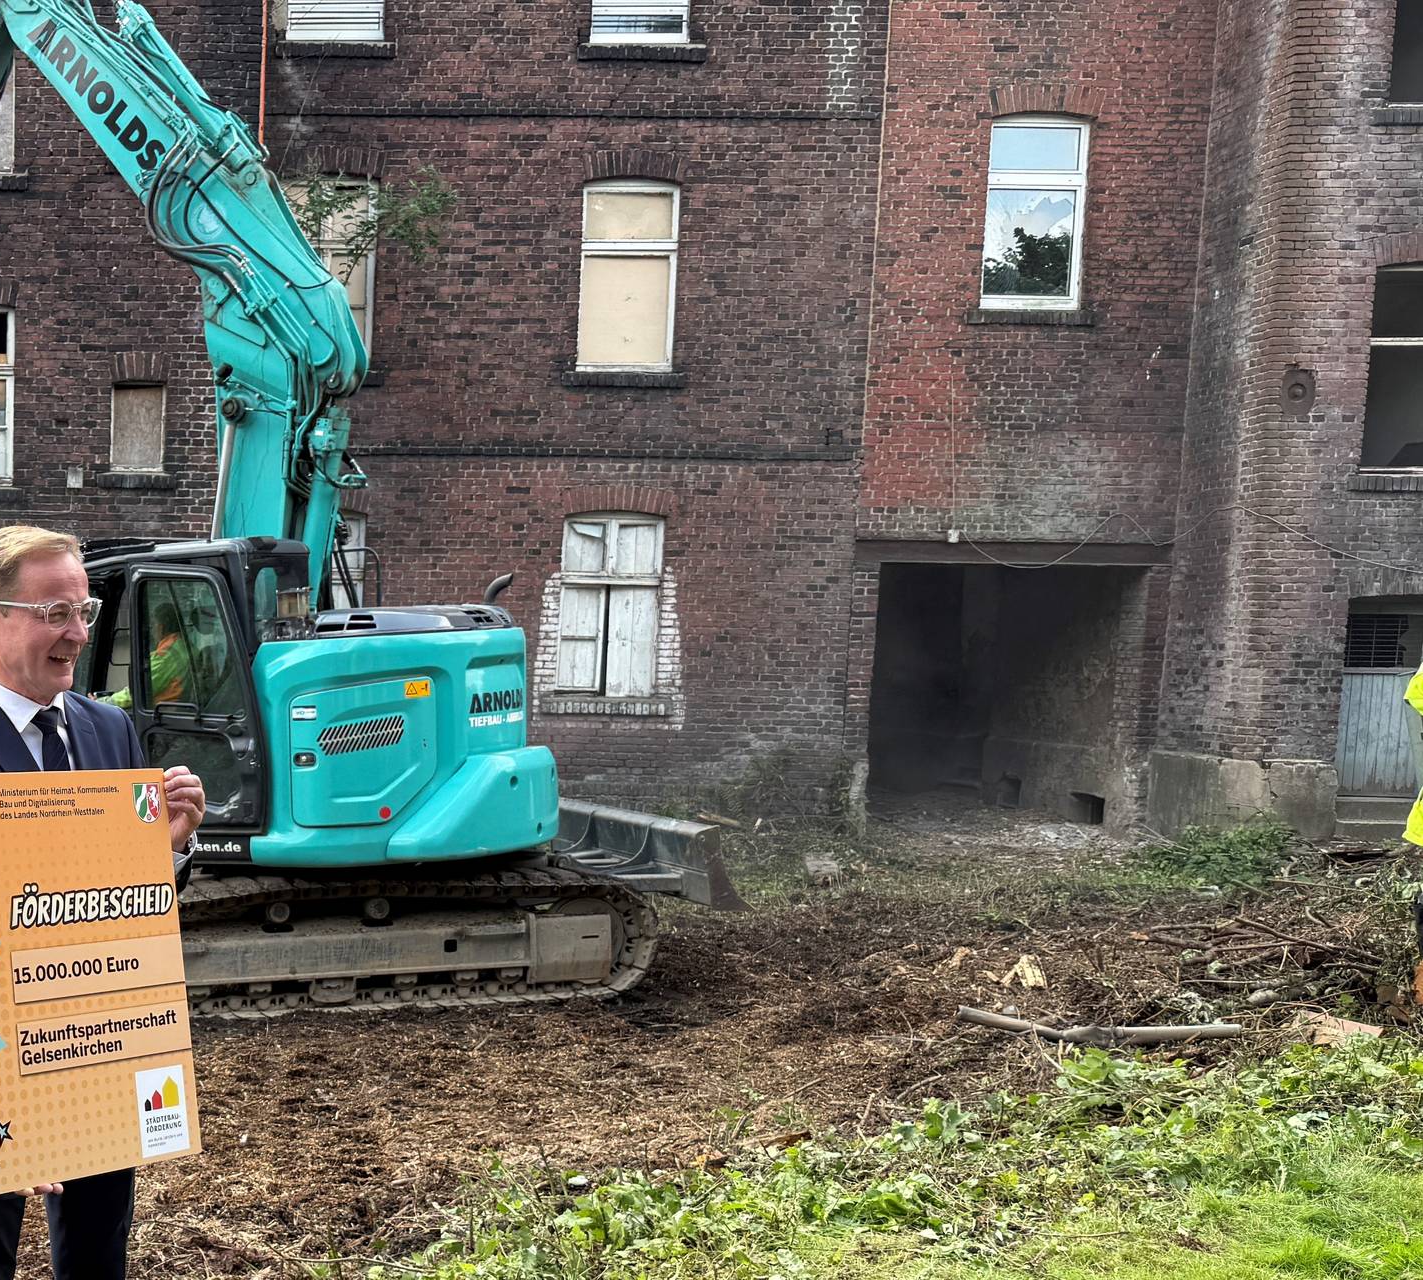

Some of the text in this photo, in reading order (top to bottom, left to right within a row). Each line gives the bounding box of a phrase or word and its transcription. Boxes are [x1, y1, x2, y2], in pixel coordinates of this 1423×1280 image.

[26, 18, 166, 170] ARNOLDS
[468, 714, 502, 727] TIEFBAU
[39, 787, 49, 796] für
[0, 798, 76, 809] Bau und Digitalisierung
[0, 807, 105, 820] des Landes Nordrhein-Westfalen
[10, 882, 175, 930] FÖRDERBESCHEID
[13, 956, 140, 985] 15.000.000 Euro
[20, 1009, 177, 1047] Zukunftspartnerschaft
[21, 1039, 123, 1066] Gelsenkirchen
[146, 1120, 182, 1134] FÖRDERUNG
